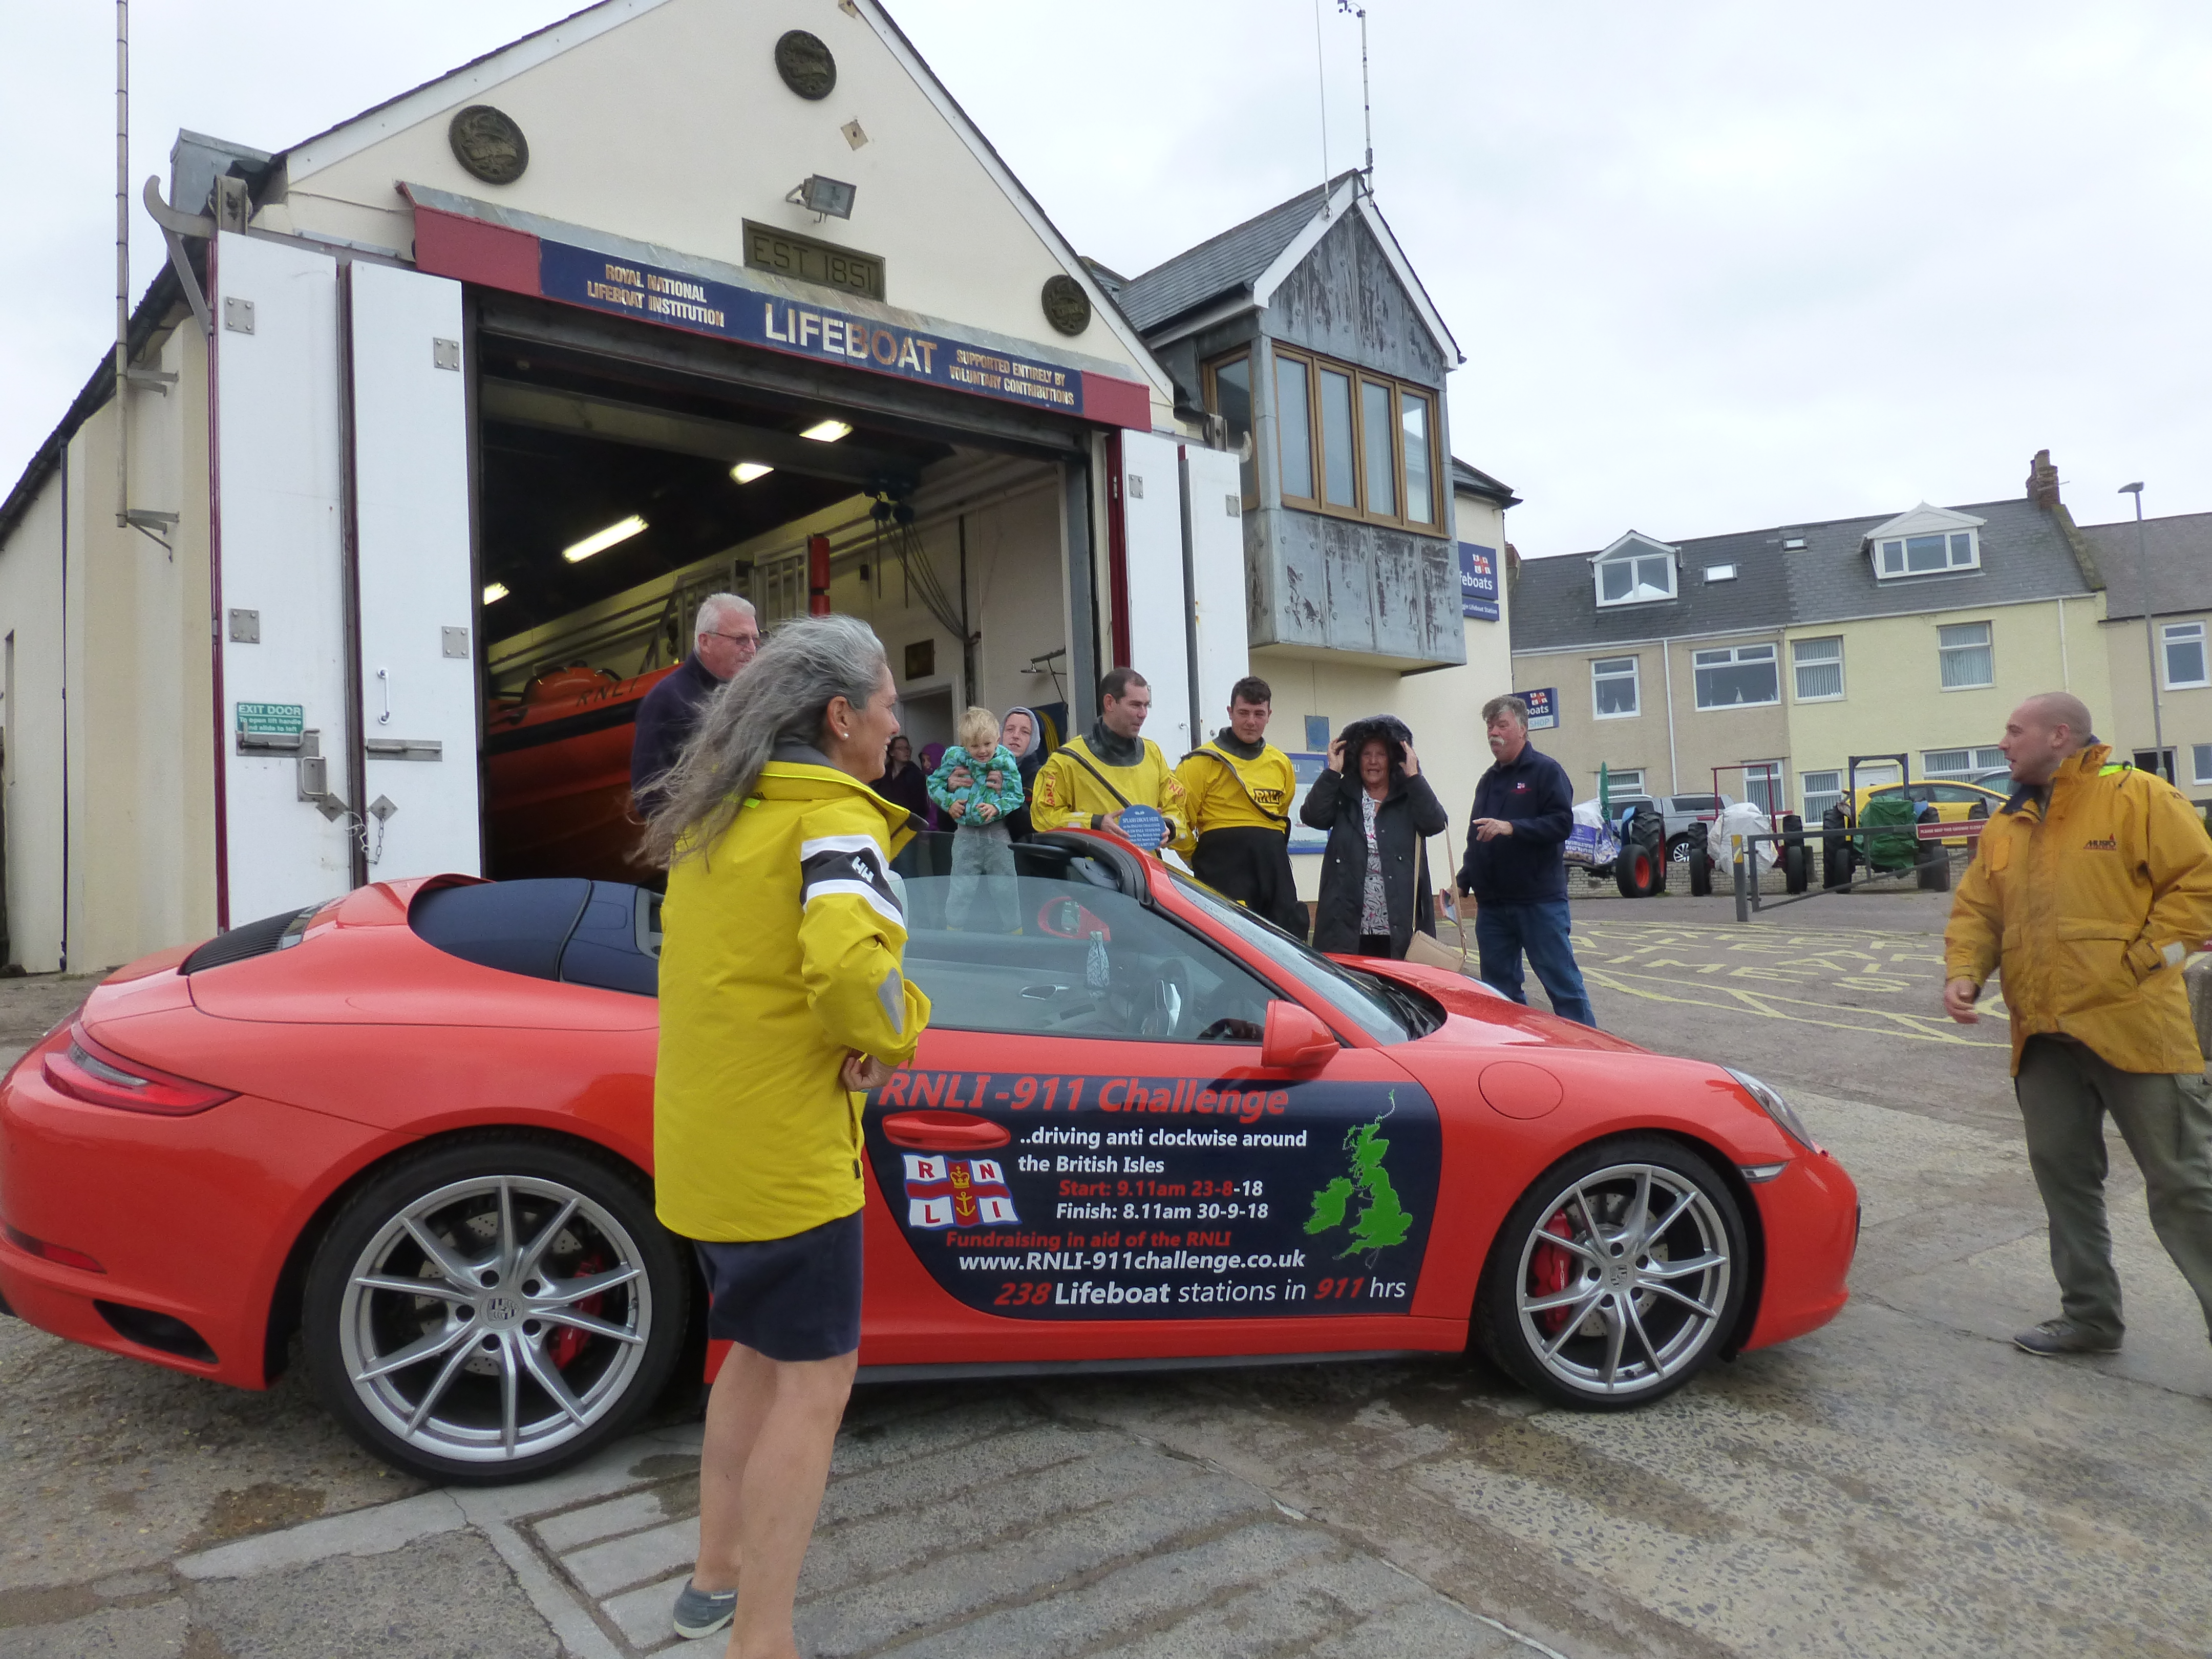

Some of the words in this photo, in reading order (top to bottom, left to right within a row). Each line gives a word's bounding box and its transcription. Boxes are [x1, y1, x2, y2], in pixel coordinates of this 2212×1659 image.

[754, 236, 808, 273] EST
[825, 256, 871, 291] 1851
[605, 264, 644, 288] ROYAL
[647, 274, 707, 303] NATIONAL
[587, 281, 645, 308] LIFEBOAT
[648, 295, 725, 328] INSTITUTION
[765, 303, 938, 374] LIFEBOAT
[956, 349, 1010, 374] SUPPORTED
[1012, 363, 1052, 384] ENTIRELY
[1054, 372, 1066, 386] BY
[949, 365, 1002, 389] VOLUNTARY
[1004, 378, 1074, 406] CONTRIBUTIONS
[576, 677, 638, 707] RNLI
[239, 705, 264, 714] EXIT
[267, 706, 301, 715] DOOR
[1529, 718, 1549, 727] SHOP
[1098, 1078, 1288, 1124] Challenge
[1106, 1128, 1143, 1146] anti
[1148, 1129, 1238, 1146] clockwise
[1242, 1130, 1307, 1147] around
[1018, 1154, 1050, 1172] the
[1056, 1155, 1117, 1173] British
[1123, 1156, 1164, 1173] Isles
[1059, 1180, 1111, 1197] Start:
[1117, 1180, 1185, 1197] 9.11am
[1190, 1180, 1263, 1197] 23-8-18
[1056, 1202, 1117, 1219] Finish:
[1122, 1202, 1191, 1219] 8.11am
[1197, 1202, 1268, 1219] 30-9-18
[946, 1231, 1061, 1252] Fundraising
[1067, 1231, 1084, 1247] in
[1090, 1231, 1120, 1247] aid
[1125, 1231, 1146, 1247] of
[1151, 1231, 1181, 1247] the
[1186, 1231, 1231, 1247] RNLI
[959, 1249, 1306, 1273] www.RNLI-911challenge.co.uk
[993, 1282, 1052, 1305] 238
[1055, 1281, 1171, 1305] Lifeboat
[1178, 1280, 1277, 1303] stations
[1284, 1279, 1306, 1300] in
[1314, 1277, 1365, 1300] 911
[1369, 1277, 1406, 1299] hrs
